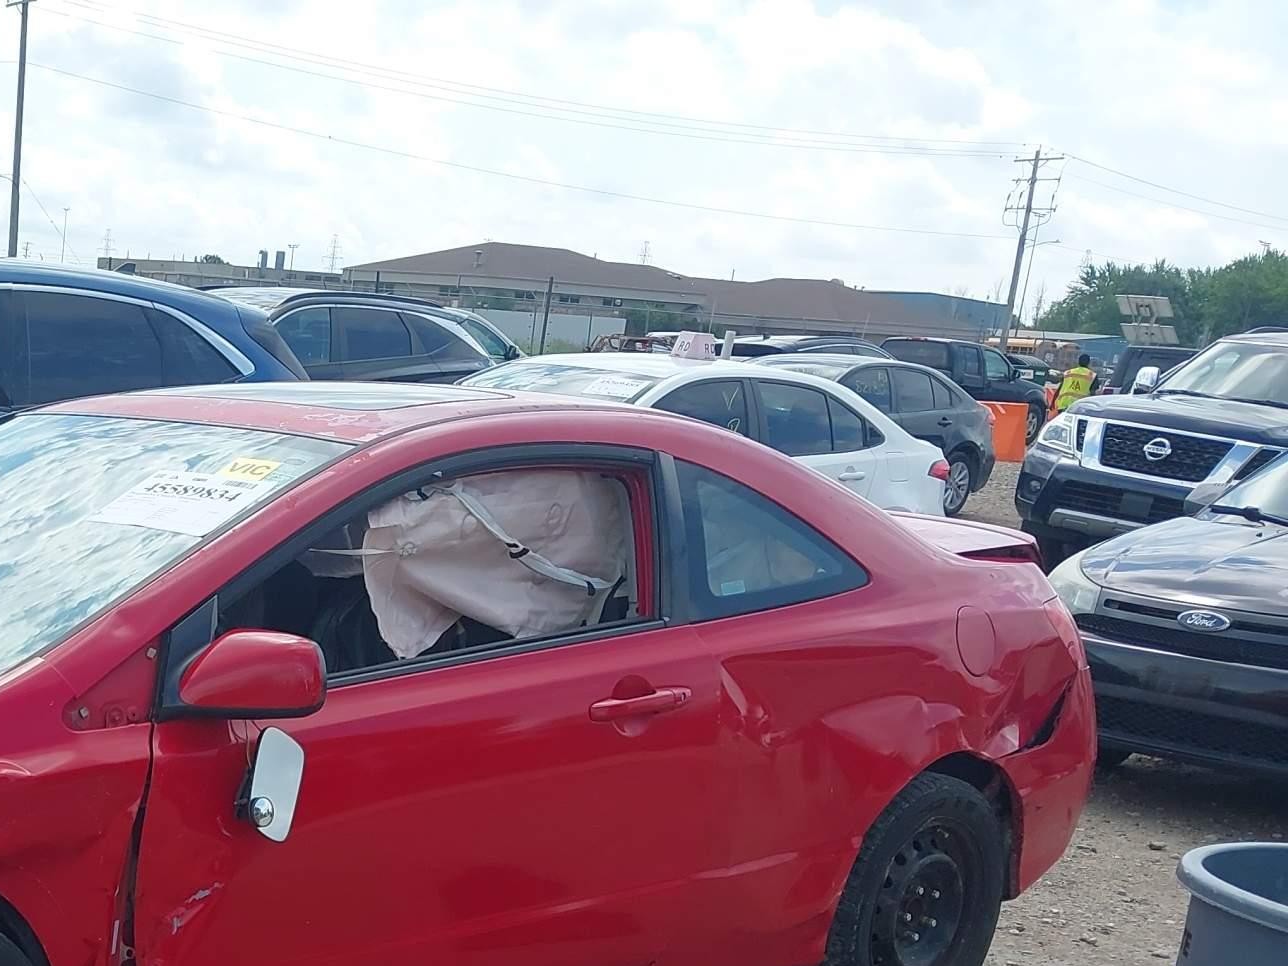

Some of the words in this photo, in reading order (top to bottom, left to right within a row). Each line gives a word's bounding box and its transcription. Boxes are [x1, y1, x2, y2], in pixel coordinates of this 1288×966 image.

[228, 461, 272, 477] VIC
[143, 482, 243, 502] 45589834
[1186, 612, 1217, 627] Ford
